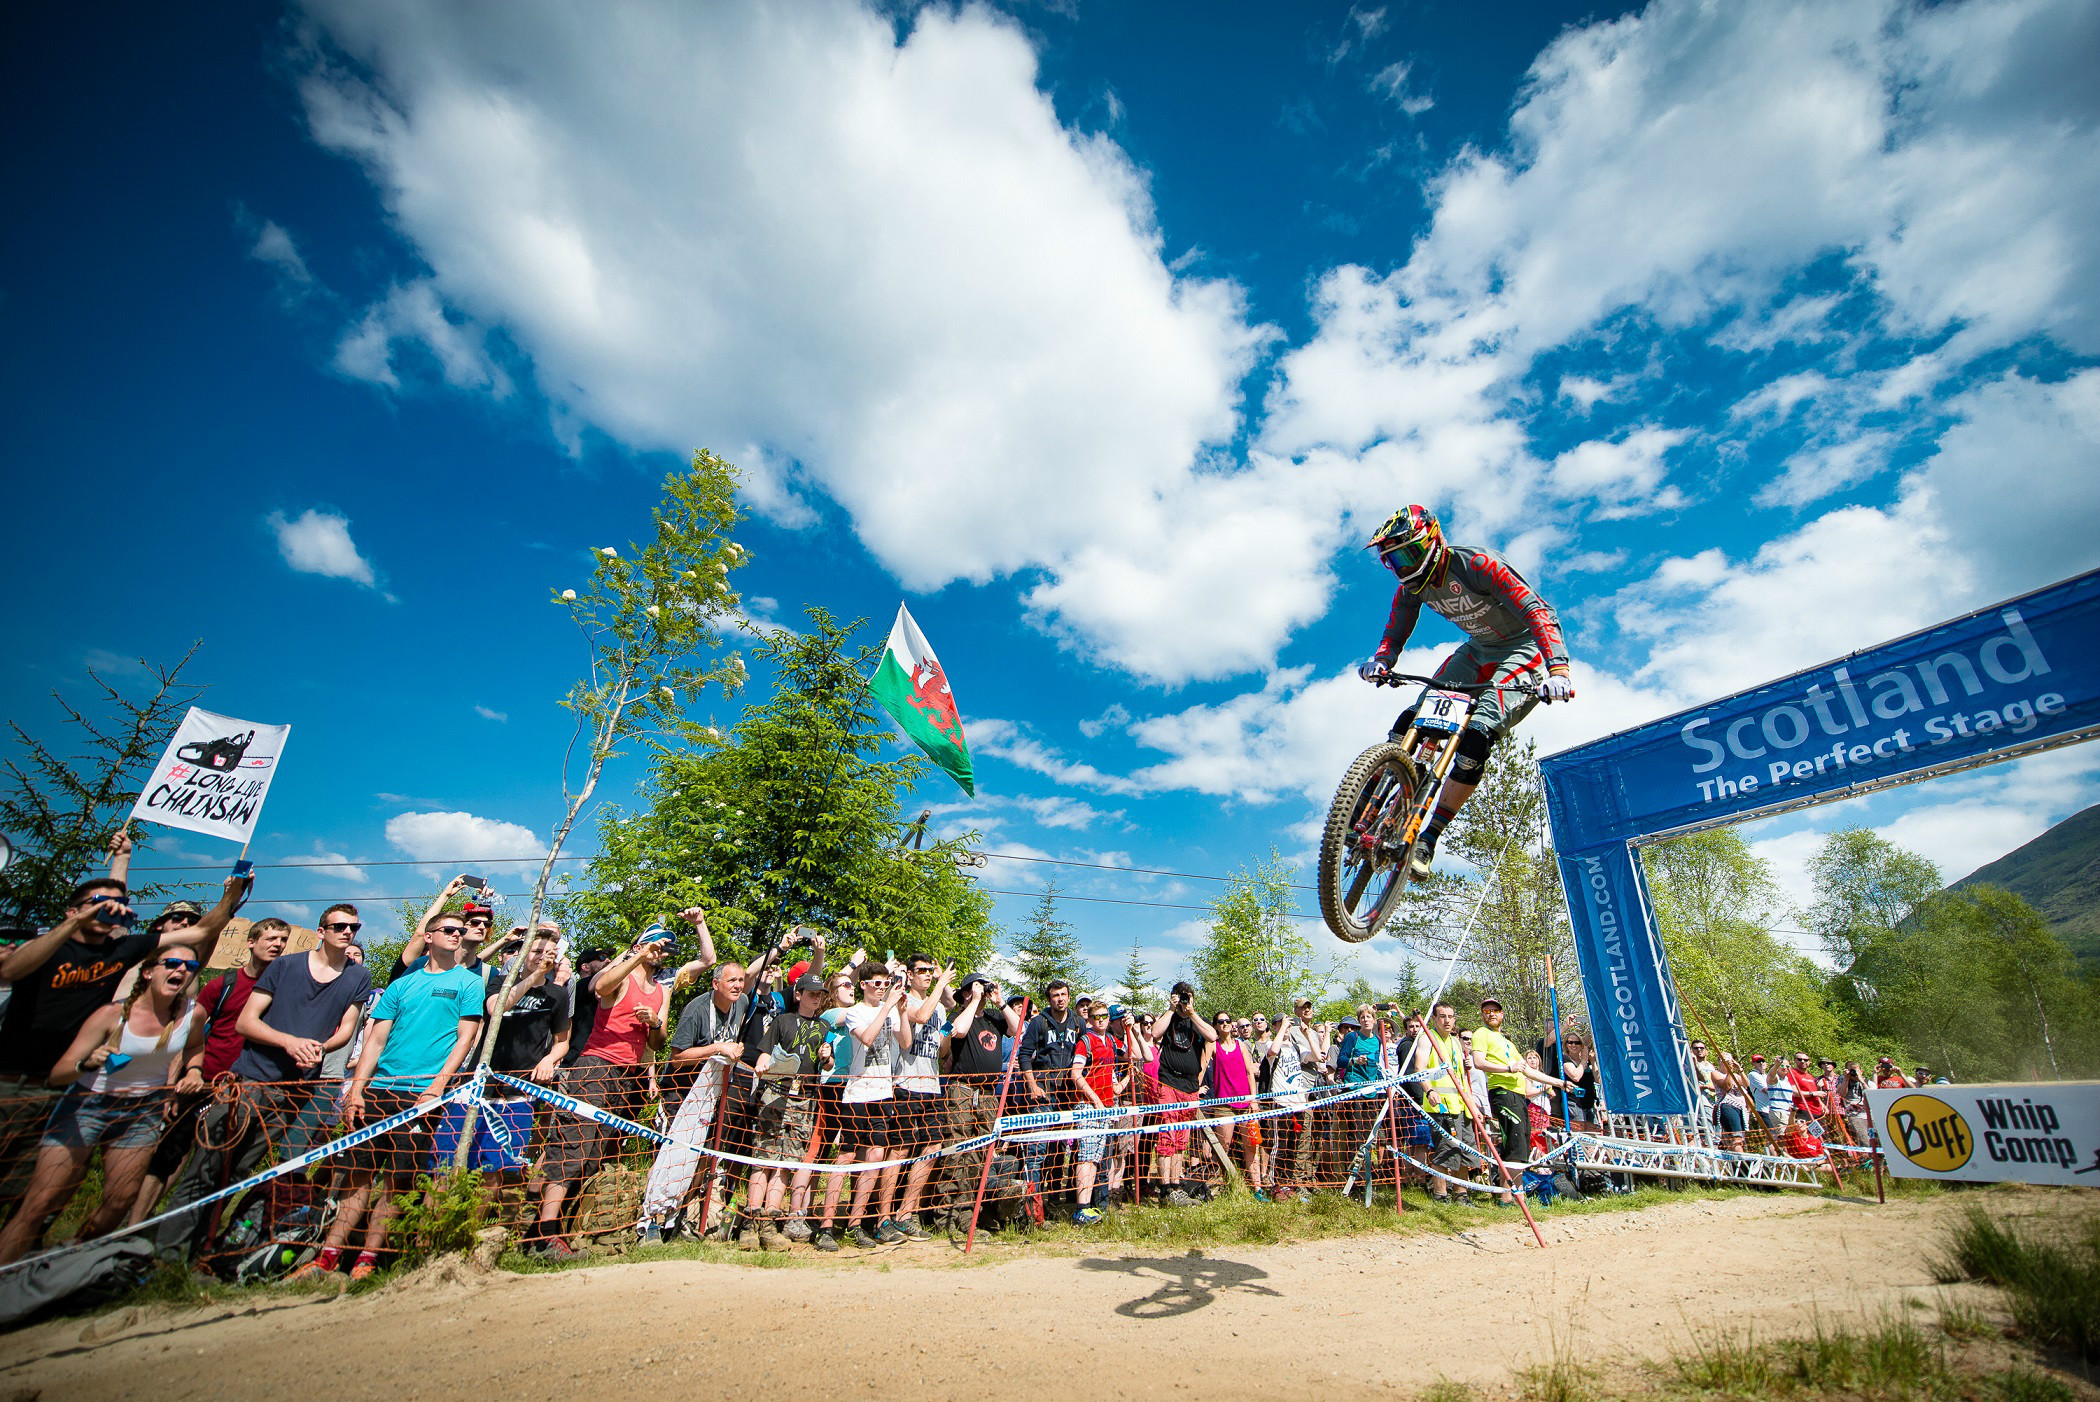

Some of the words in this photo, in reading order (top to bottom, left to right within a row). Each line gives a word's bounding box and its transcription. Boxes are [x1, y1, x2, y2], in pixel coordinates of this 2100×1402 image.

[1433, 699, 1453, 717] 18
[1681, 609, 2052, 774] Scotland
[1696, 774, 1759, 804] The
[1768, 728, 1916, 786] Perfect
[1924, 692, 2067, 746] Stage
[146, 783, 258, 825] CHAINSAW
[232, 779, 265, 801] LIVE
[1585, 855, 1653, 1101] VISITSCOTLAND.COM
[1000, 1112, 1061, 1130] SHIMANO
[1072, 1106, 1128, 1121] SHIMANO
[1138, 1100, 1190, 1114] SHIMANO
[1199, 1095, 1246, 1107] SHIMANO
[1255, 1089, 1298, 1100] SHIMANO
[1976, 1098, 2061, 1135] Whip
[1984, 1130, 2079, 1169] Comp
